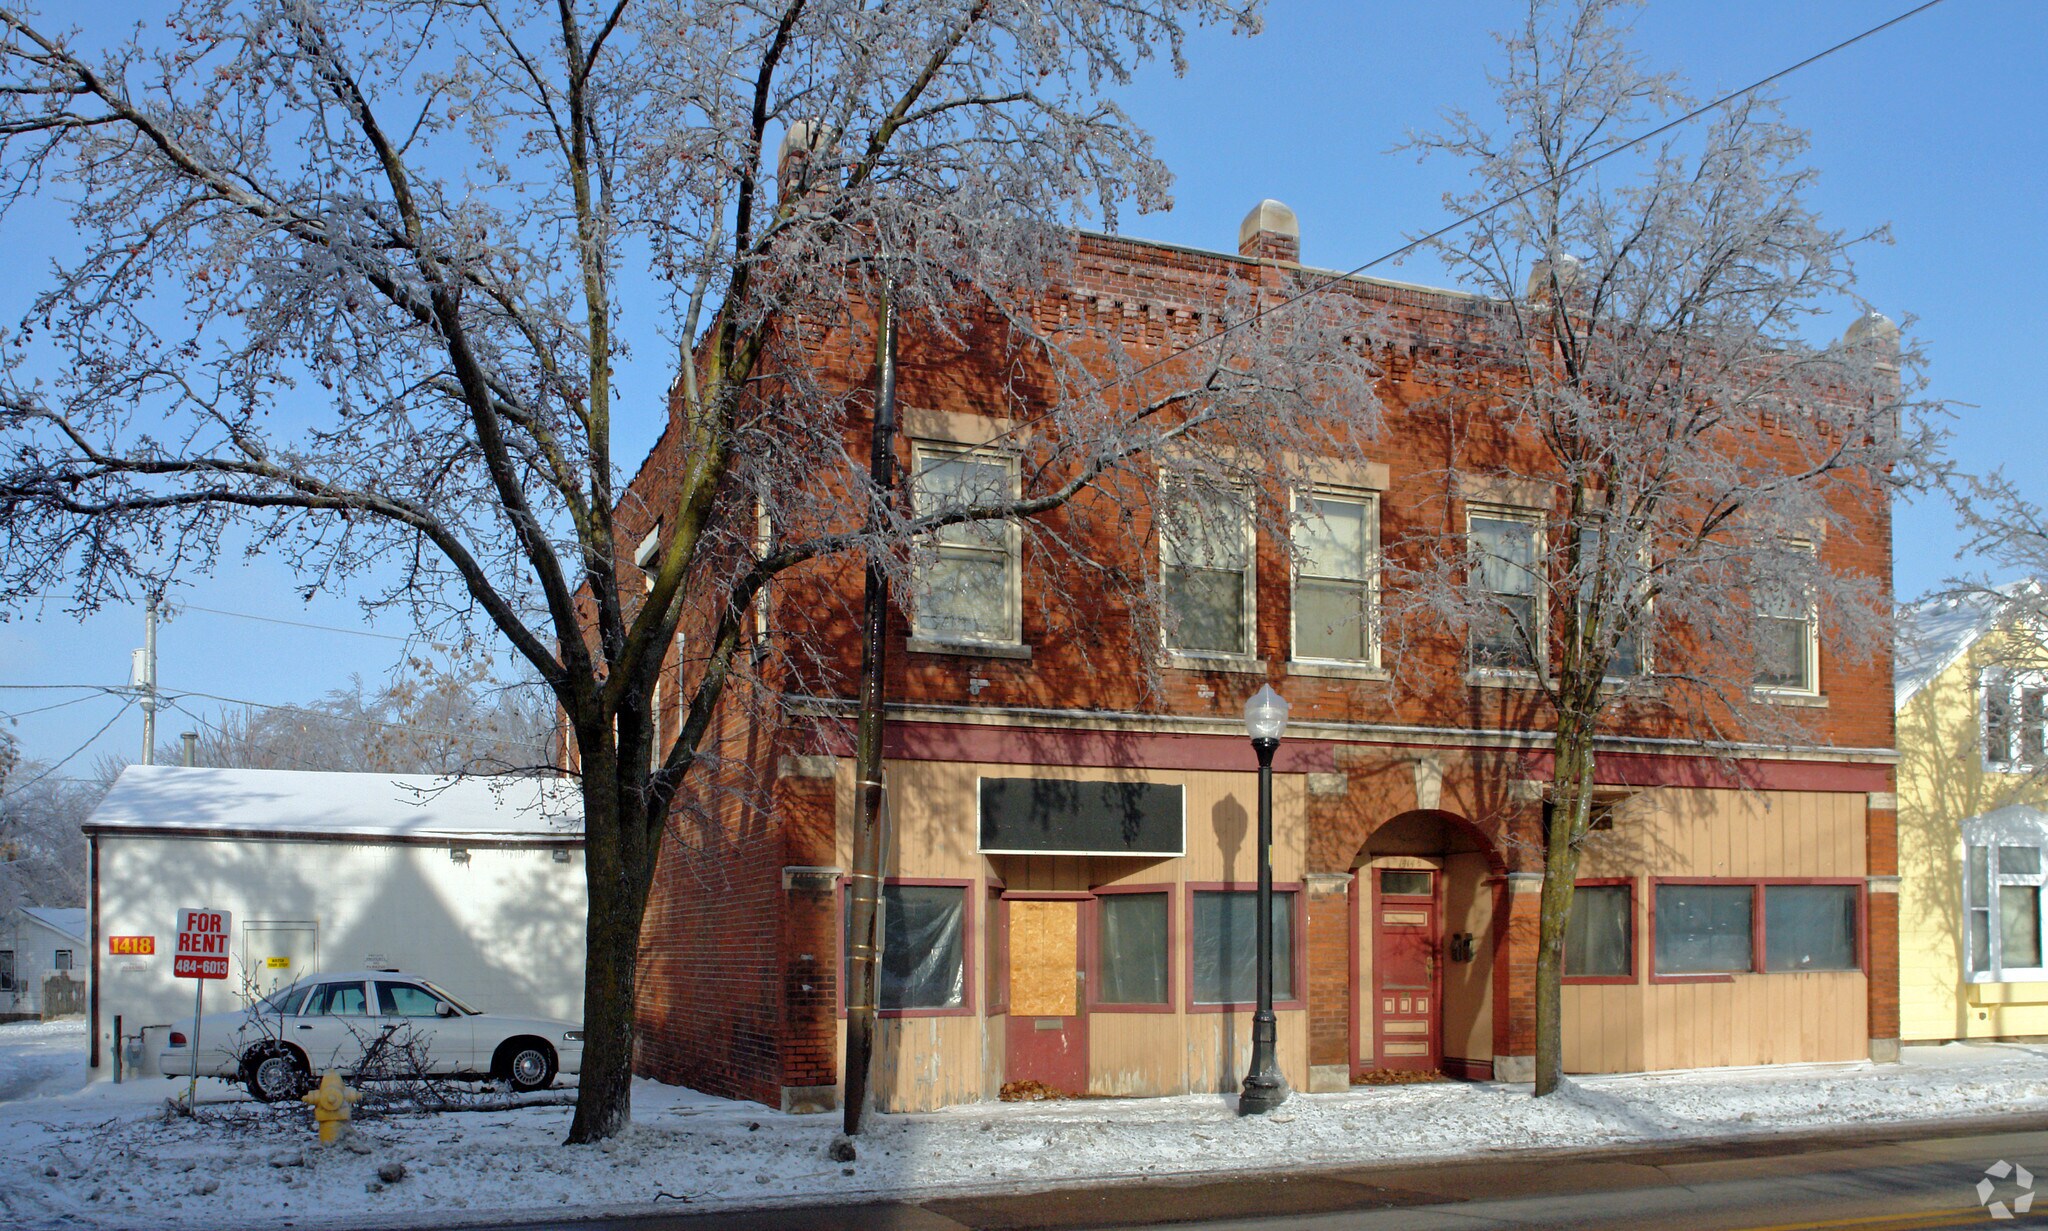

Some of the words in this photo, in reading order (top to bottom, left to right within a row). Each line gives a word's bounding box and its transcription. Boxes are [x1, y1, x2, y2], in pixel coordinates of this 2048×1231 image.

[187, 912, 222, 932] FOR
[112, 937, 151, 953] 1418
[178, 933, 228, 953] RENT
[175, 959, 227, 974] 484-6013
